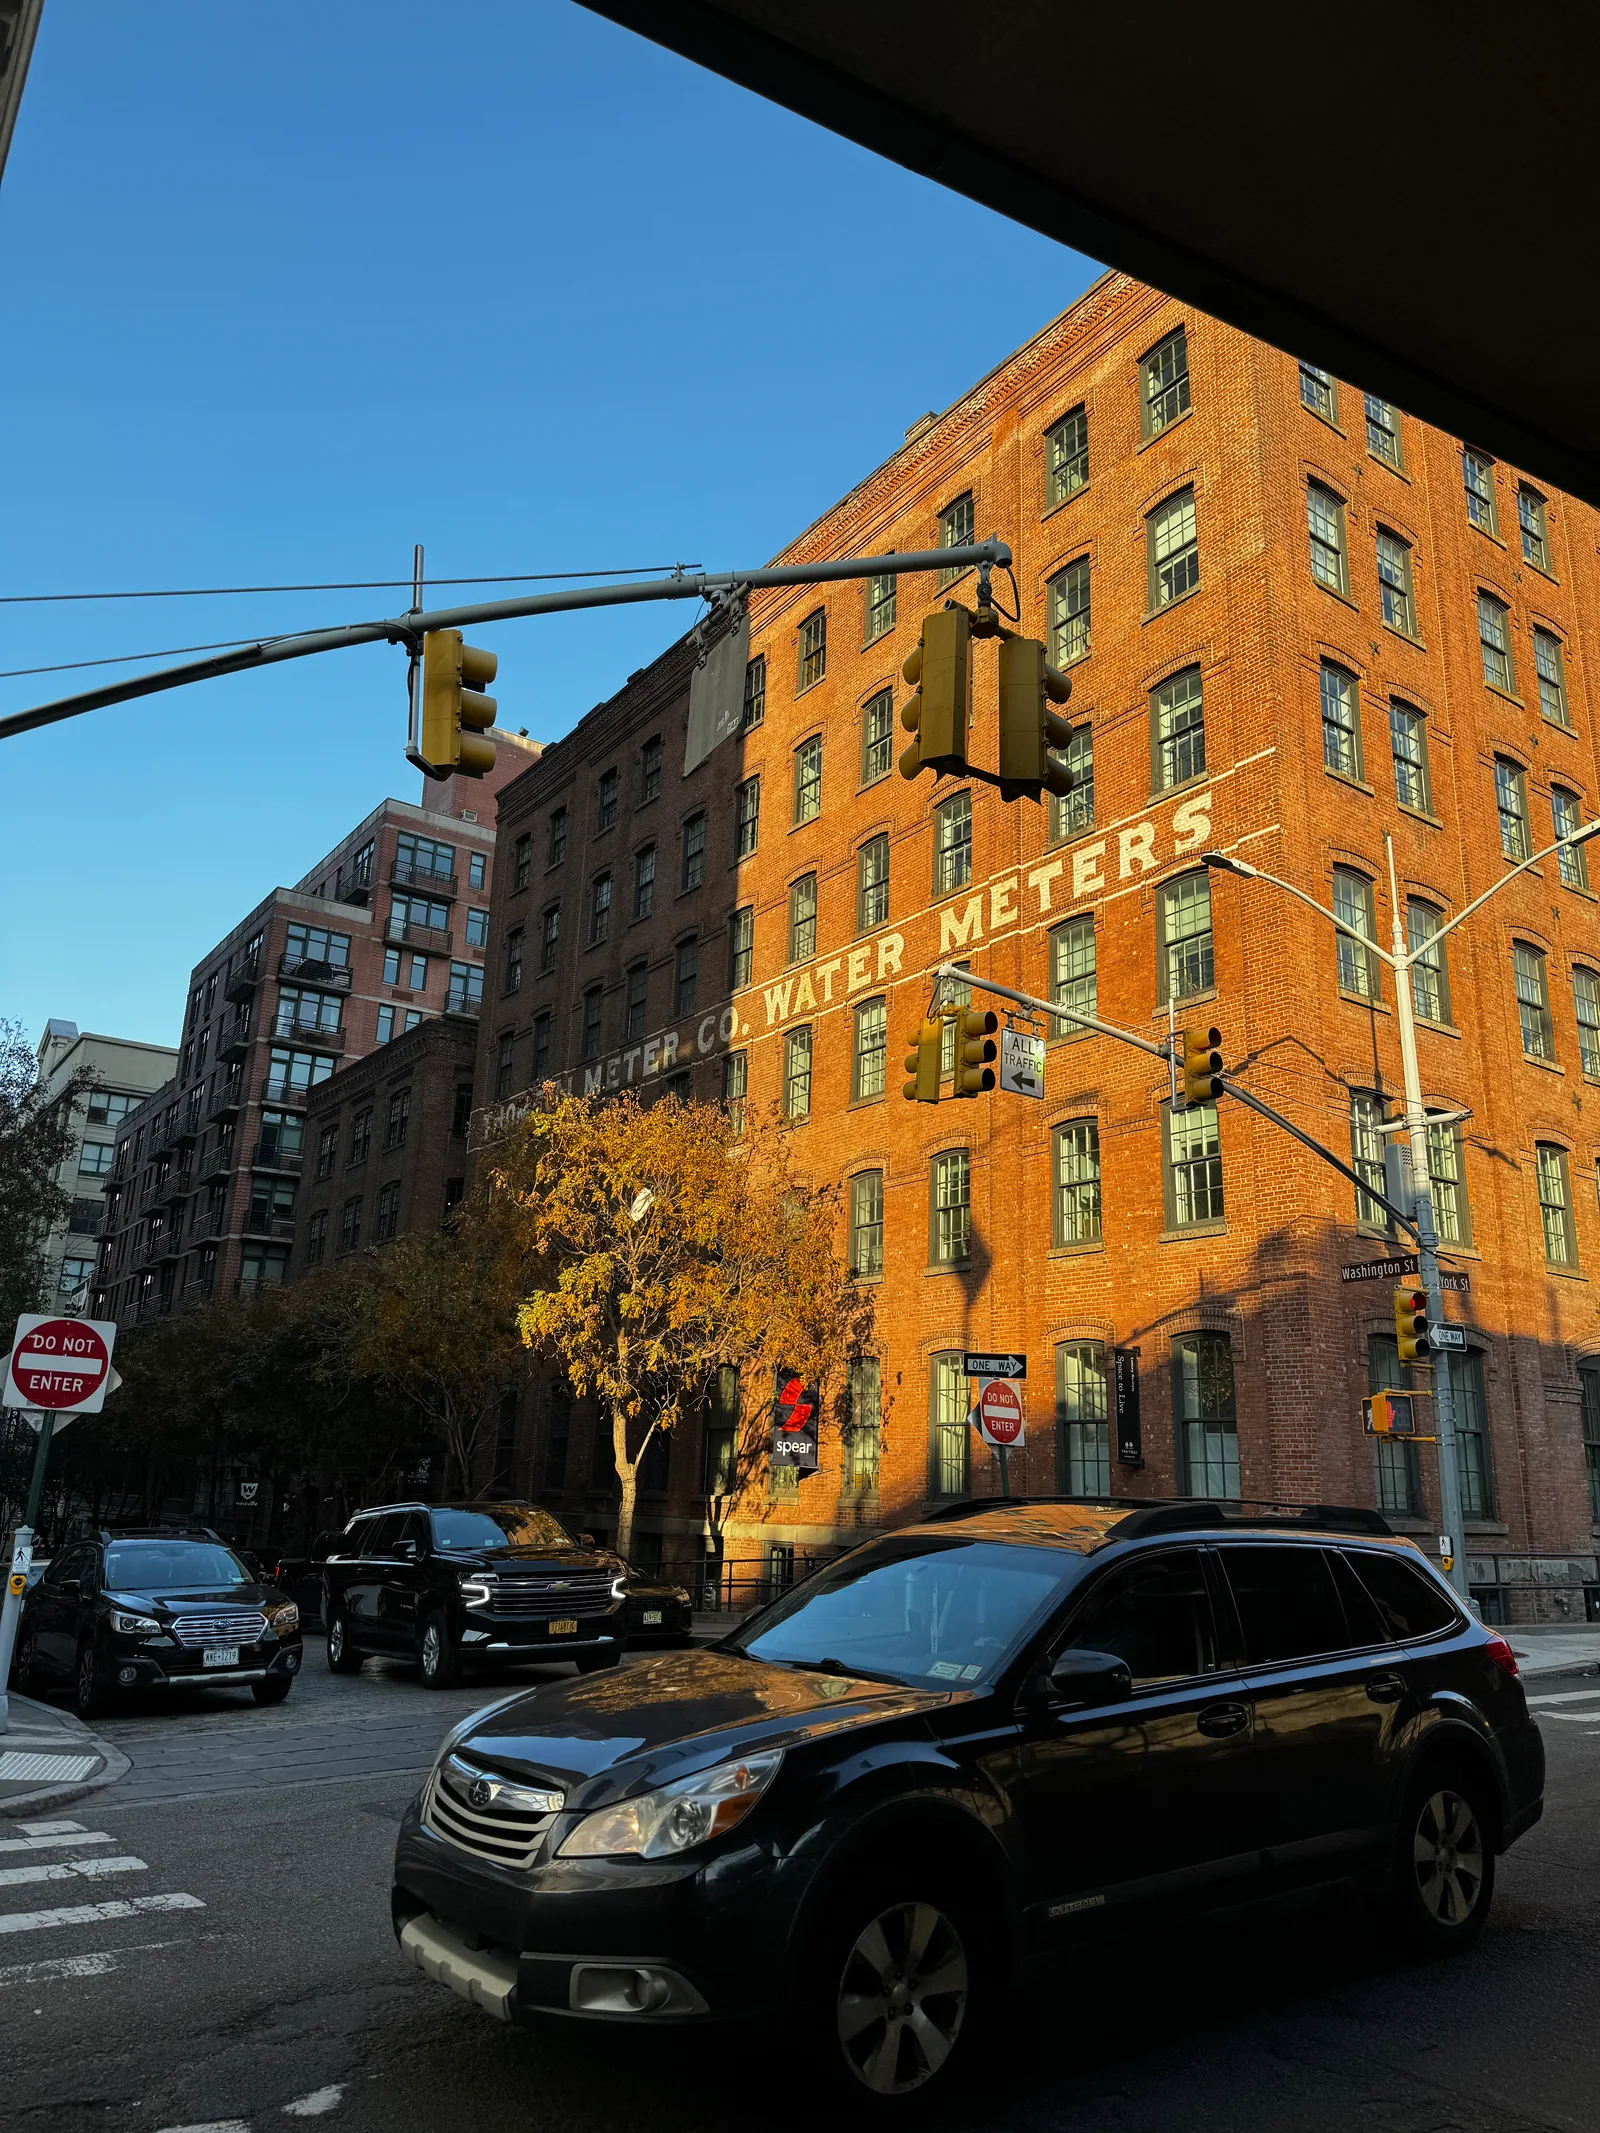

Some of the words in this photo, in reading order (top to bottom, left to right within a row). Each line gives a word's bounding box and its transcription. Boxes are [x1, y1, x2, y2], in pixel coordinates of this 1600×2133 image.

[584, 1031, 679, 1095] METER
[698, 1007, 750, 1054] CO.
[763, 932, 905, 1026] WATER
[939, 791, 1213, 954] METERS
[1012, 1037, 1035, 1055] ALL
[1004, 1052, 1042, 1073] TRAFFIC
[1341, 1263, 1401, 1280] Washington
[1404, 1258, 1415, 1272] St
[1439, 1275, 1457, 1289] York
[1460, 1278, 1469, 1291] St
[33, 1335, 56, 1349] DO
[63, 1337, 95, 1353] NOT
[1439, 1330, 1449, 1339] ONE
[1450, 1332, 1461, 1342] WAY
[972, 1361, 990, 1370] ONE
[998, 1361, 1018, 1372] WAY
[1116, 1355, 1125, 1380] Space
[29, 1375, 84, 1393] ENTER
[1118, 1383, 1124, 1391] to
[987, 1392, 998, 1403] DO
[999, 1393, 1014, 1405] NOT
[1118, 1394, 1126, 1414] Live
[991, 1420, 1015, 1432] ENTER
[776, 1440, 812, 1456] spear
